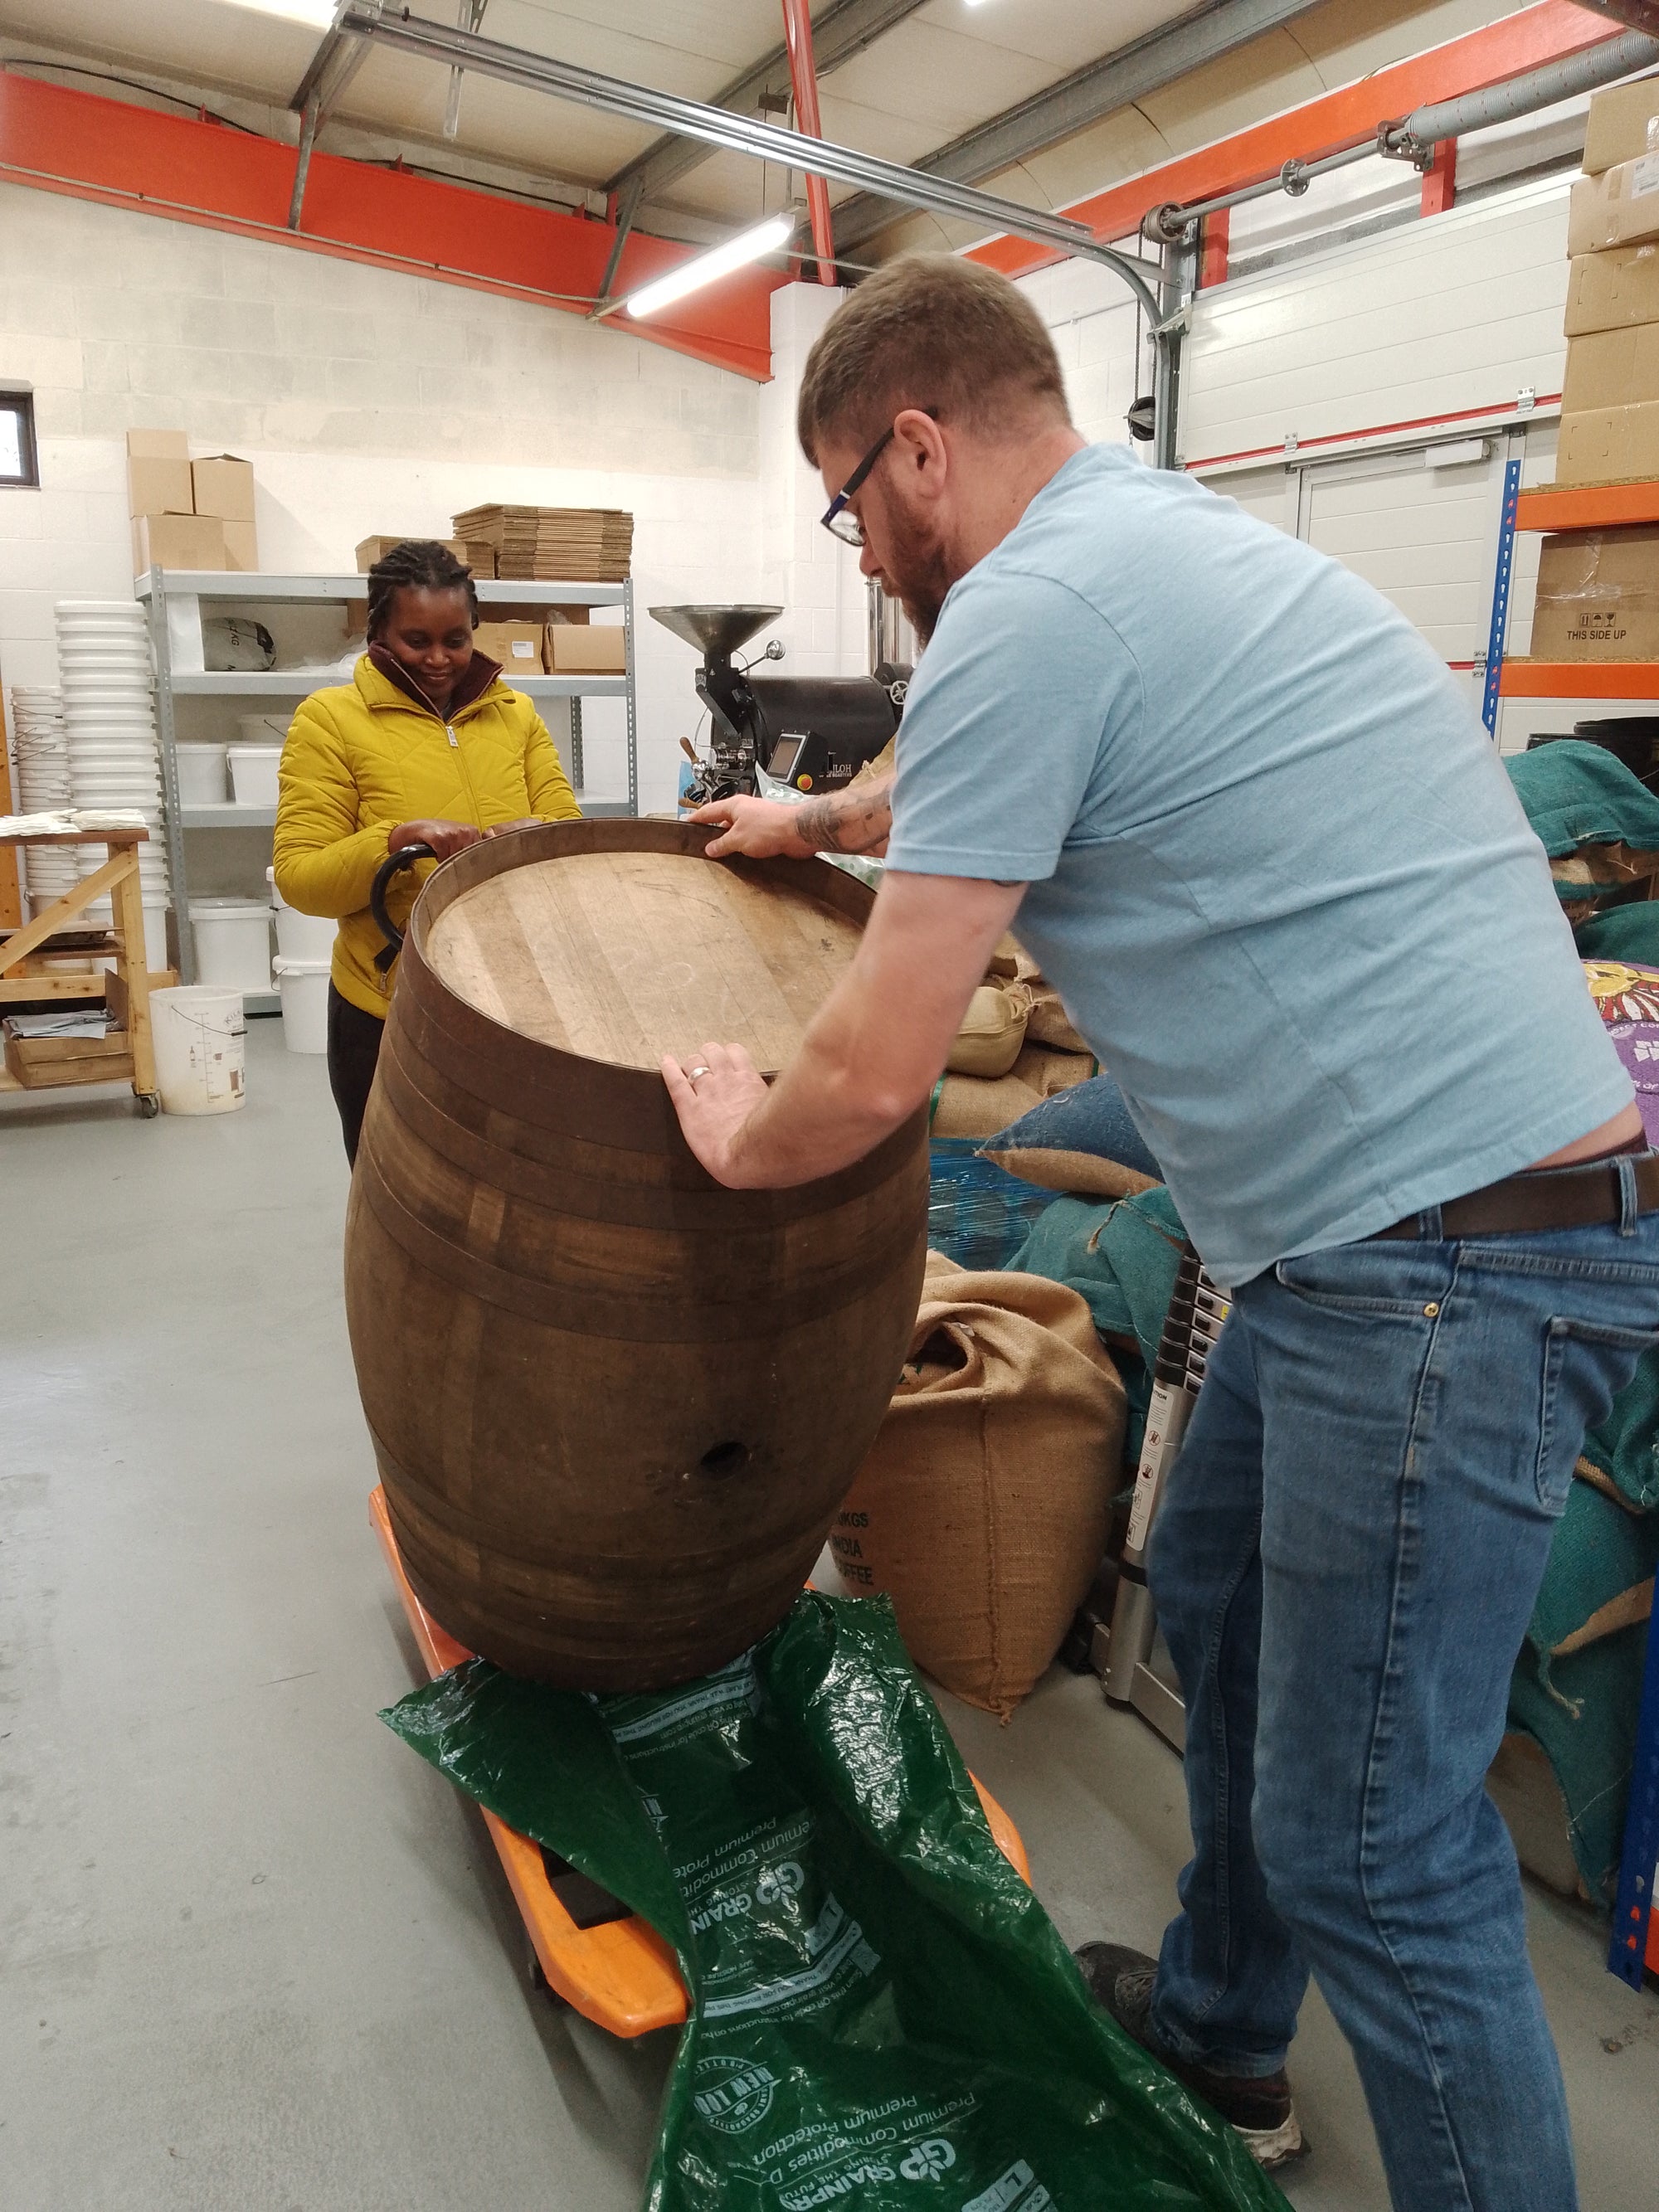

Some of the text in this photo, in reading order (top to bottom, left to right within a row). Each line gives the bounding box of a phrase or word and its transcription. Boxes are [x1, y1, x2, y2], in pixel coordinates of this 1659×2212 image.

[1567, 630, 1627, 640] THIS SIDE UP
[839, 1512, 869, 1527] KGS
[673, 1816, 776, 1879] Premium Prote
[683, 1821, 810, 1898] emium Commodit
[690, 1893, 752, 1935] GRAIN
[694, 2067, 774, 2115] NEW LOO
[902, 2093, 975, 2132] Premium
[752, 2095, 917, 2166] Premium Protection
[789, 2127, 897, 2172] Commodities
[786, 2181, 815, 2200] FUTU
